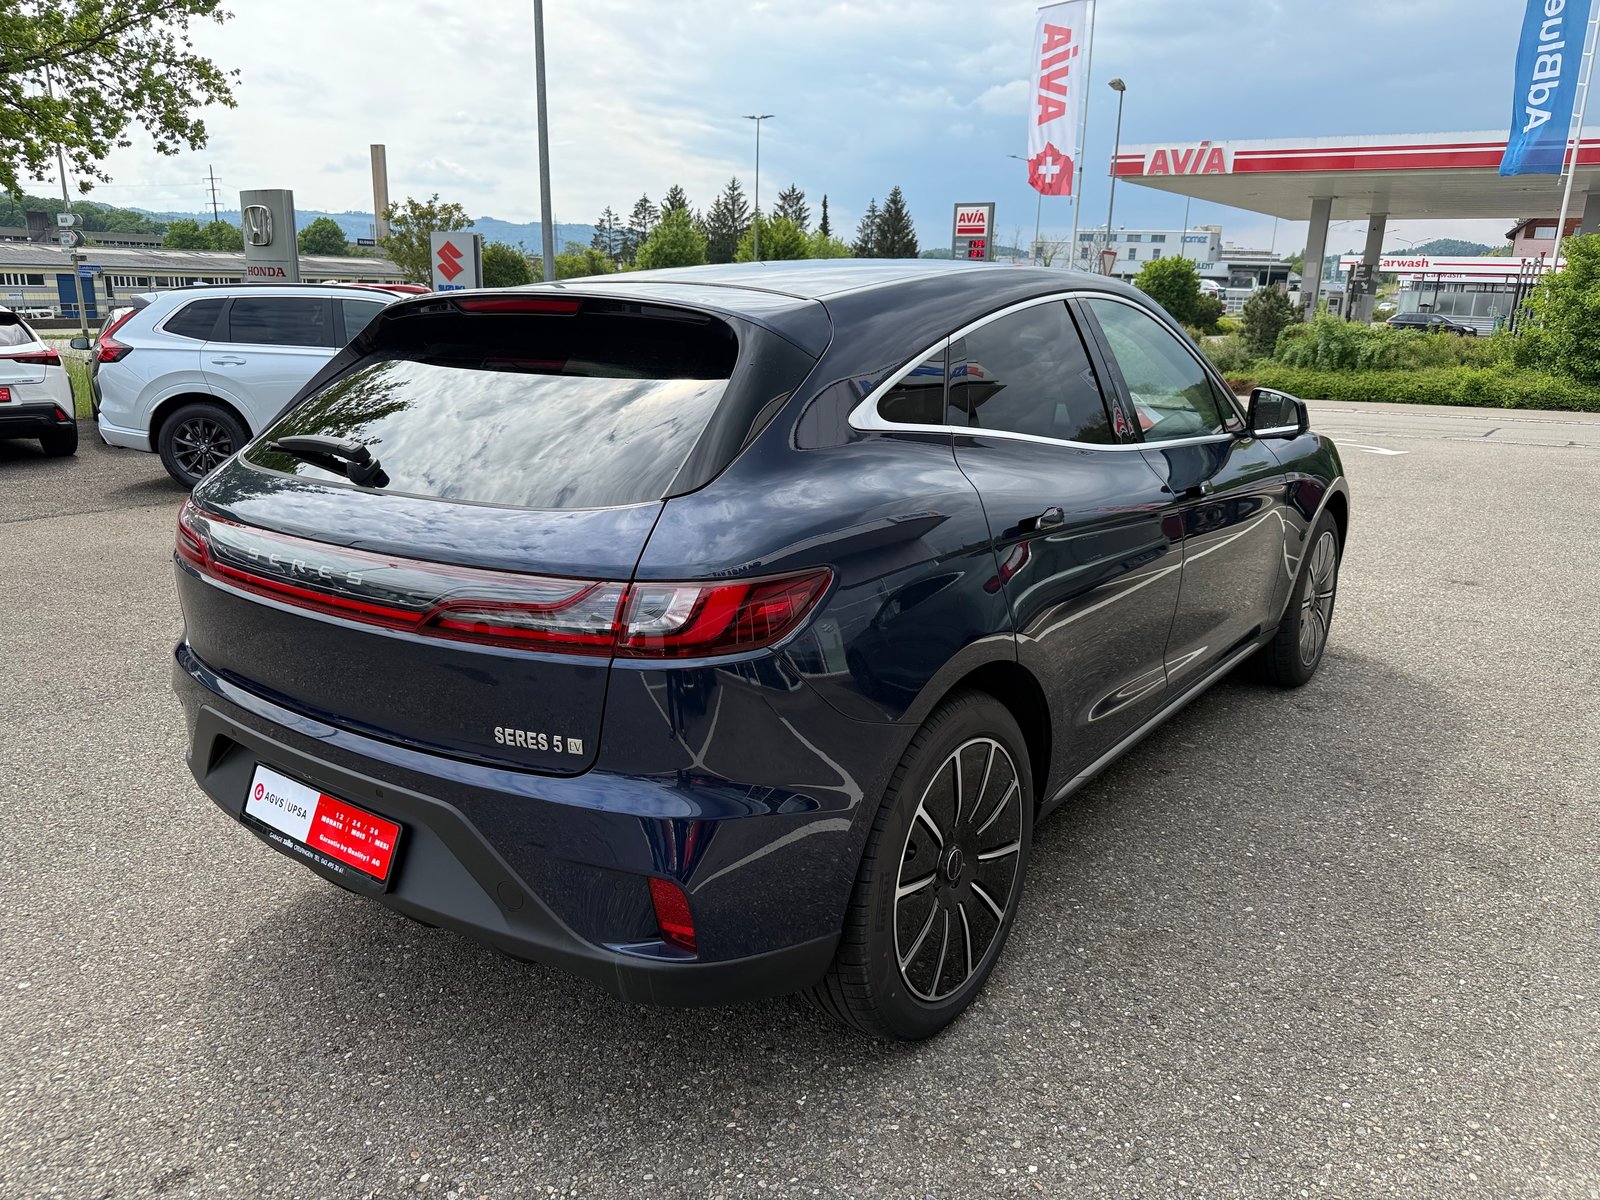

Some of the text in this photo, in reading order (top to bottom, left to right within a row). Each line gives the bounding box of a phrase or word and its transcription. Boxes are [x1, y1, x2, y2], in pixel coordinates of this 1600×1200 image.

[1147, 140, 1226, 175] AVIA
[958, 210, 985, 223] AVIA
[247, 266, 286, 277] HONDA
[248, 547, 364, 585] SERES
[494, 726, 549, 751] SERES
[553, 735, 563, 753] 5
[264, 791, 307, 820] AGVS UPSA
[320, 815, 343, 830] MONATE
[350, 829, 366, 840] MOIS
[374, 840, 389, 851] MESI
[335, 812, 344, 820] 12
[351, 820, 361, 829] 24
[319, 834, 341, 848] Garantie
[371, 859, 381, 867] AG
